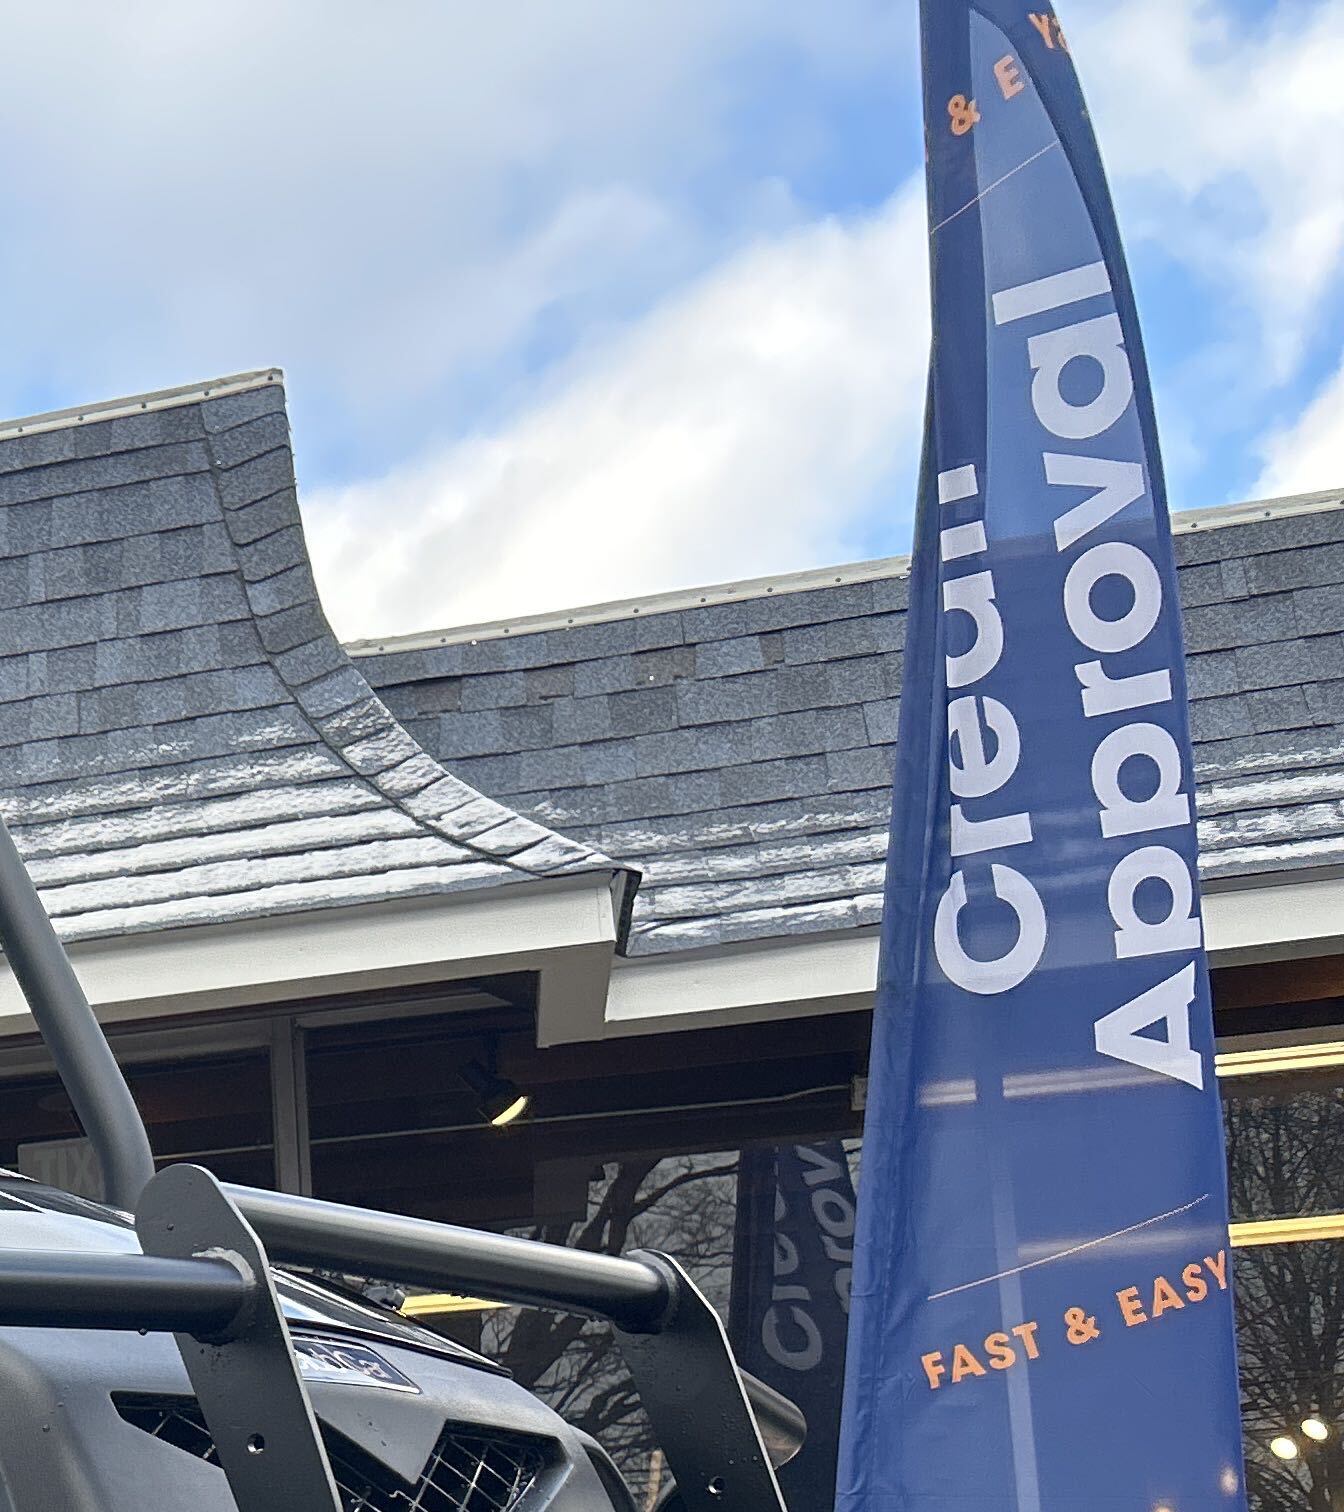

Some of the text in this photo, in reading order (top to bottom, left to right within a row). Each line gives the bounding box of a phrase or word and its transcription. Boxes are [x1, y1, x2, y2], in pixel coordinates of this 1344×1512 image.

[991, 260, 1204, 1090] Approval
[920, 1250, 1230, 1390] FAST & EASY
